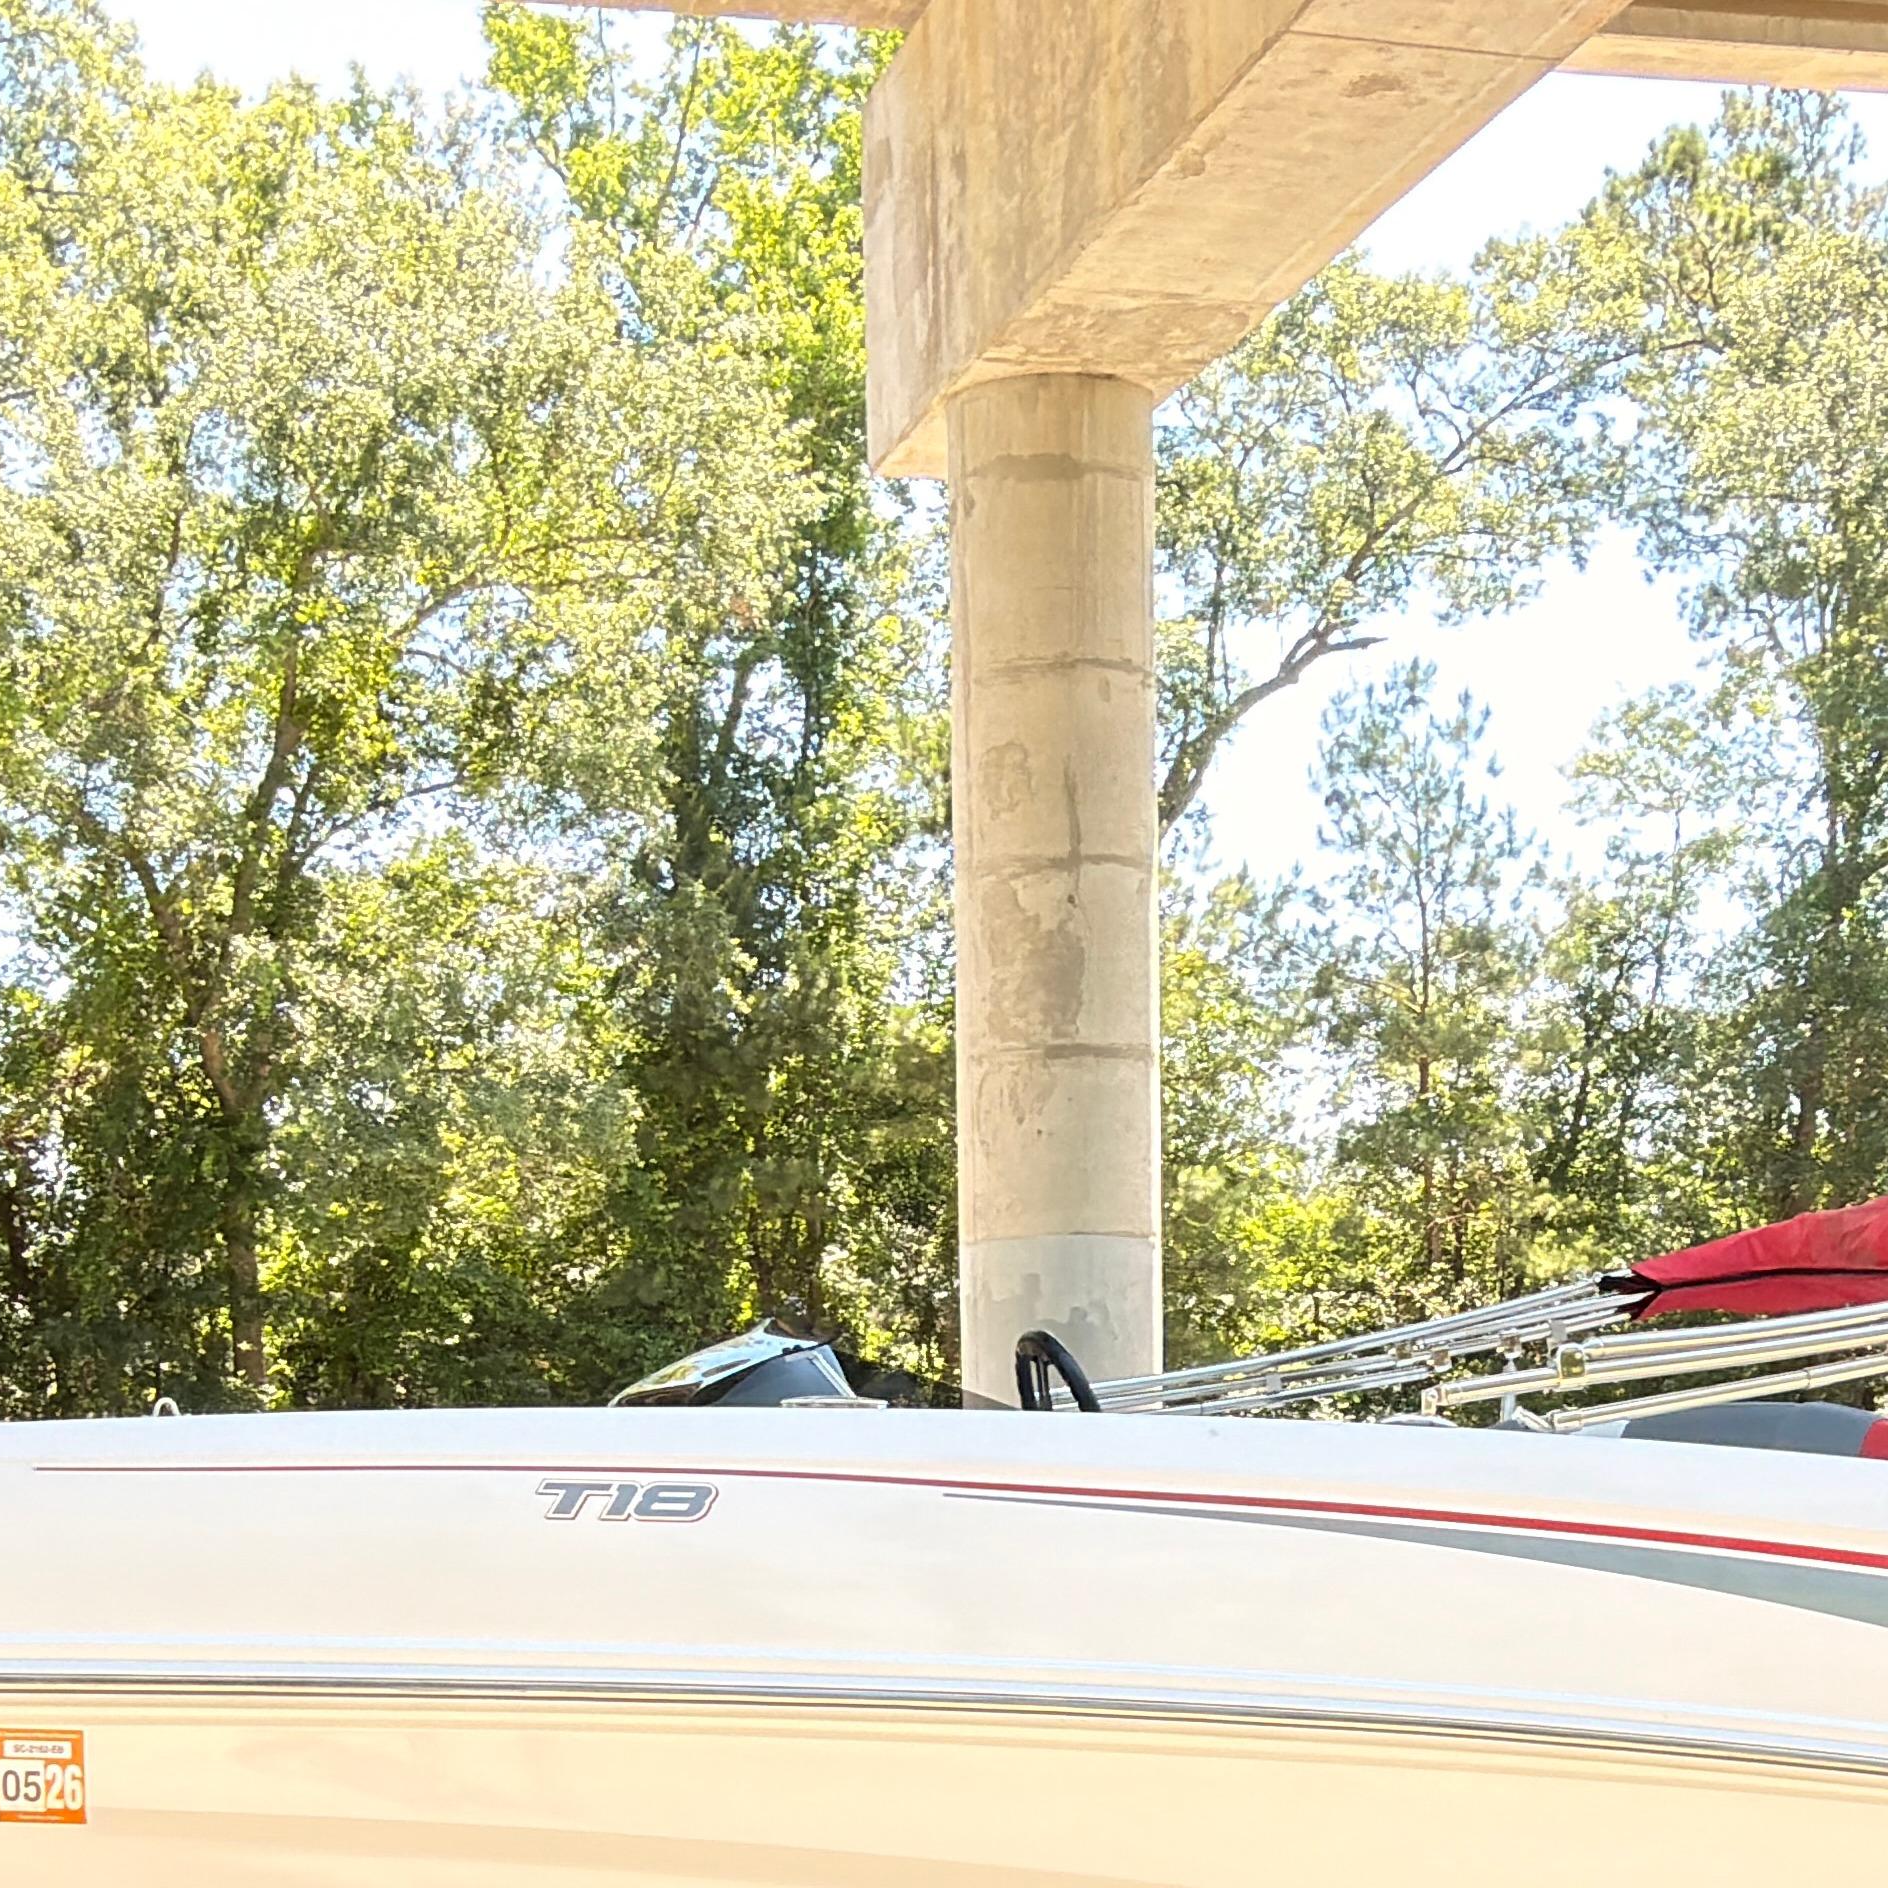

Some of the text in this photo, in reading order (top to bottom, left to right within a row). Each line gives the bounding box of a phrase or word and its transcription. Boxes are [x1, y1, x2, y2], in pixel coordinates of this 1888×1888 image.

[535, 1478, 719, 1522] T18
[2, 1764, 83, 1811] 05 26
